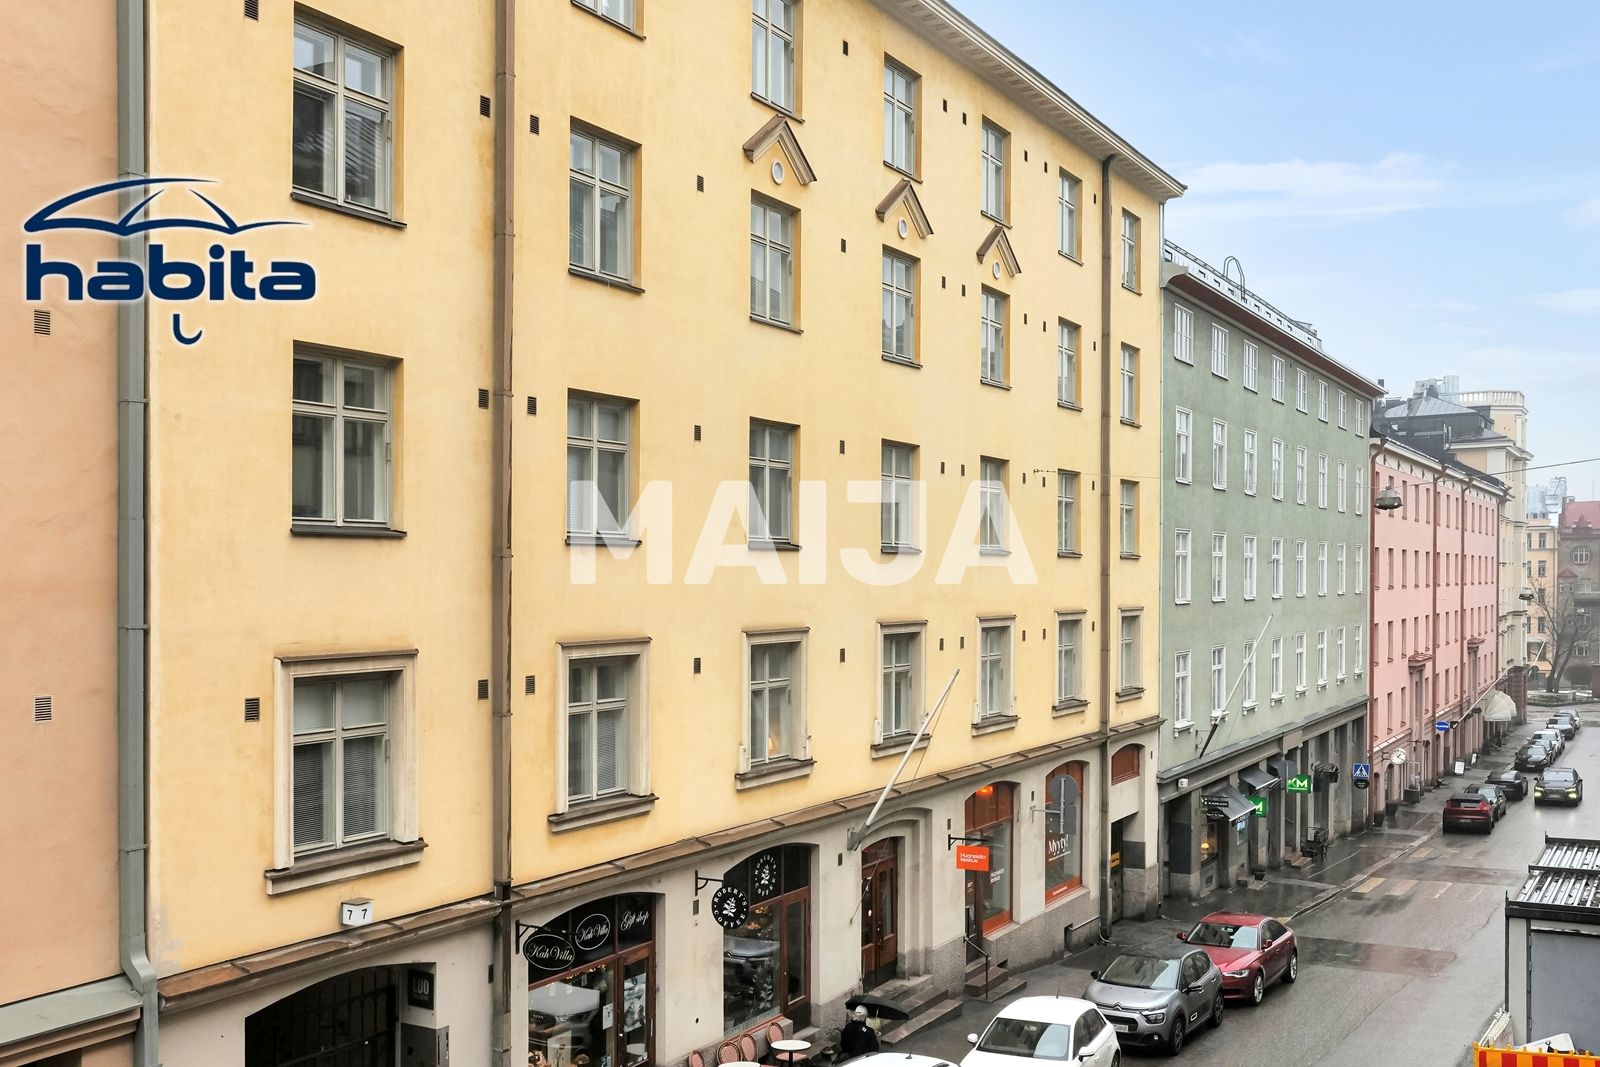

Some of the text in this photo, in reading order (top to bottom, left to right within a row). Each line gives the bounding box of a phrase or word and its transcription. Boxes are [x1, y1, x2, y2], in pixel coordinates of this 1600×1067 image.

[713, 887, 747, 906] ROBERT'S
[347, 909, 353, 920] 7
[361, 908, 368, 919] 7
[714, 910, 746, 928] COFFEE
[549, 945, 573, 961] Villa
